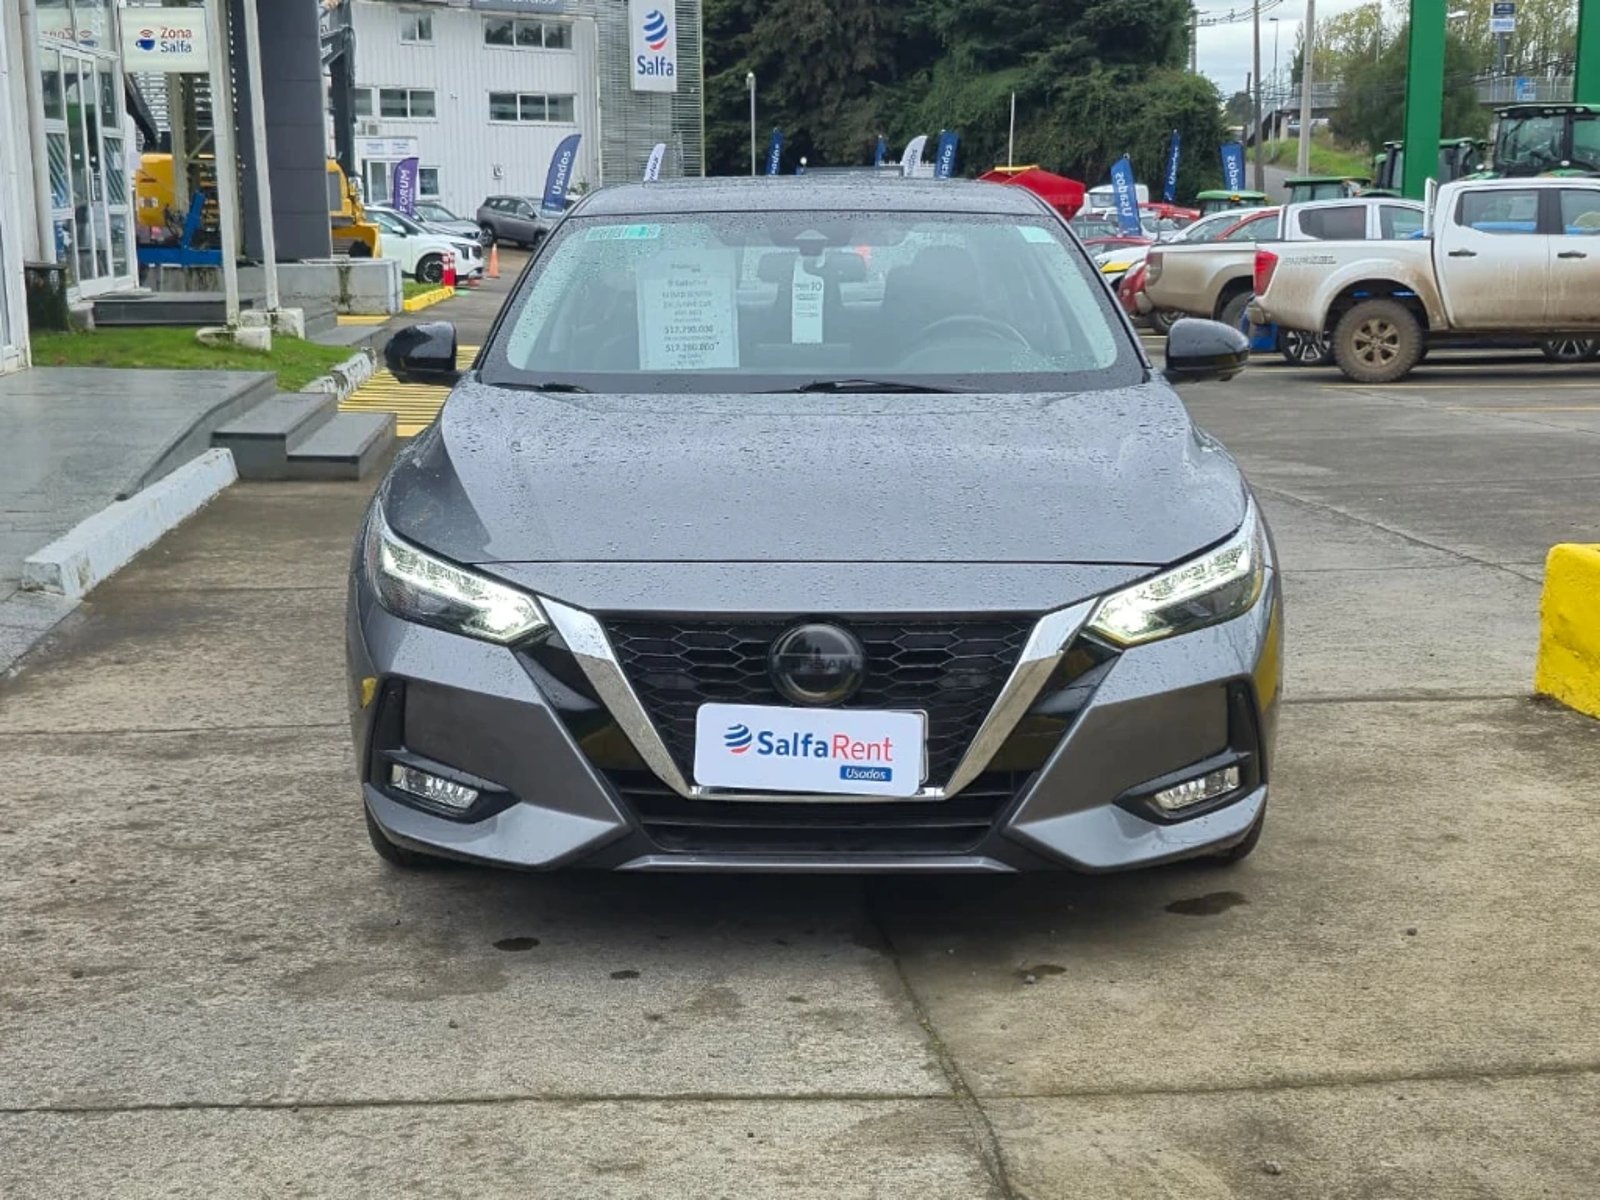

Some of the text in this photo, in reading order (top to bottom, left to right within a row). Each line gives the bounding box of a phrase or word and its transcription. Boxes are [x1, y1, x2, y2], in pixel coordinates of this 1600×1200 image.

[160, 27, 192, 39] Zona
[160, 41, 192, 53] Salfa
[637, 55, 674, 77] Salfa
[551, 150, 571, 195] Usados
[399, 169, 410, 212] FORUM
[756, 730, 893, 762] SalfaRent
[846, 768, 886, 780] Usados
